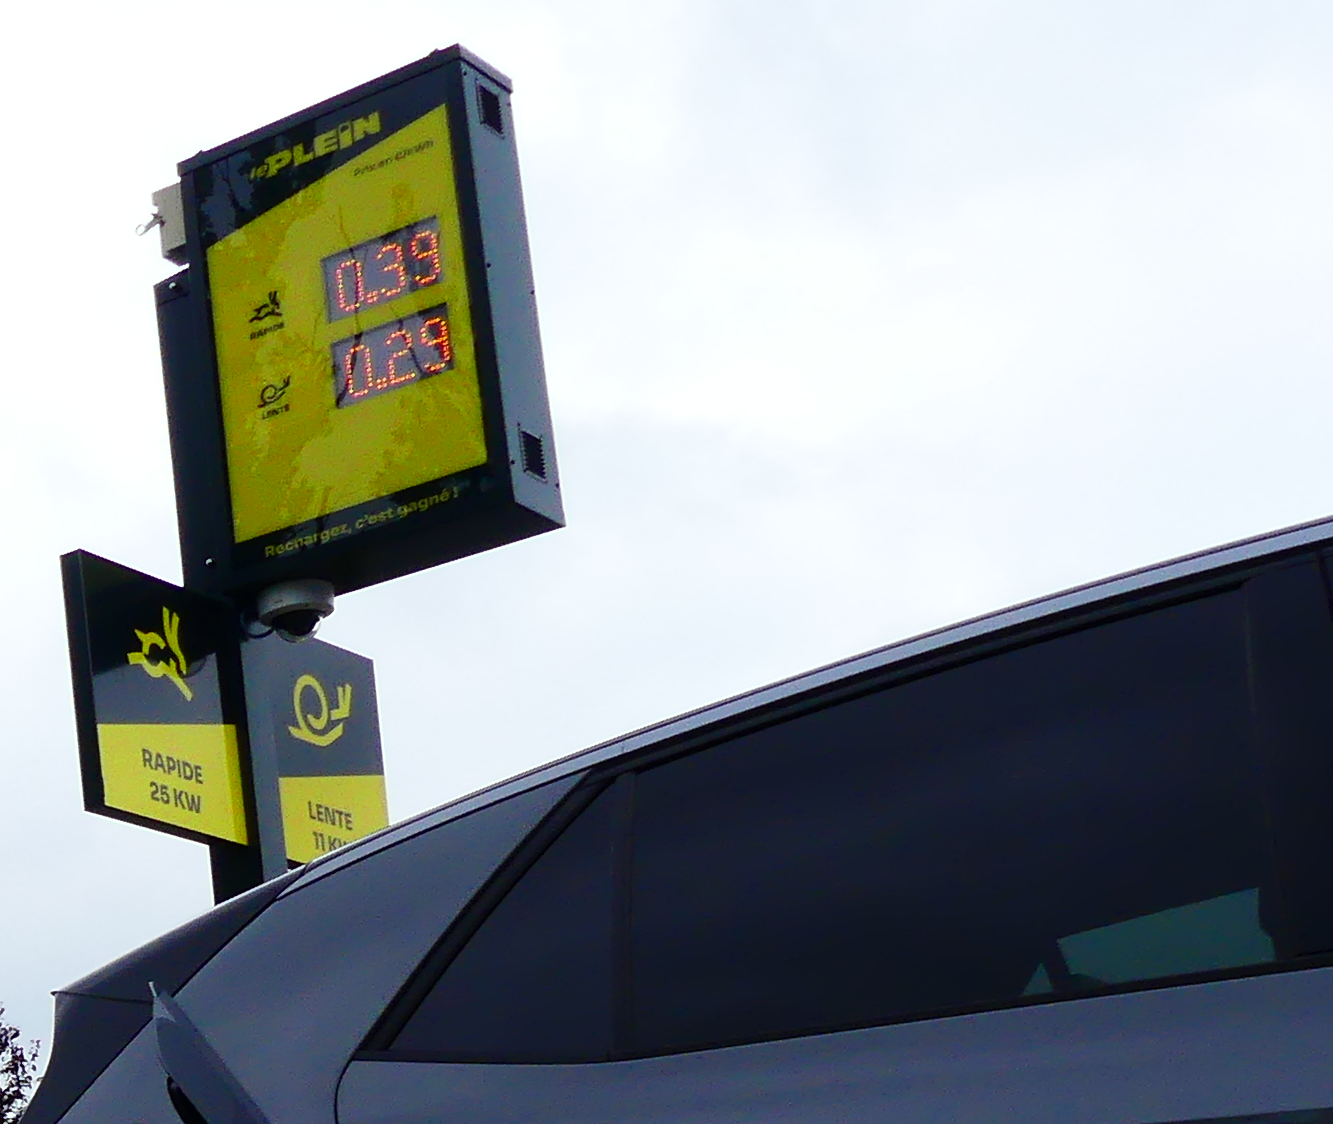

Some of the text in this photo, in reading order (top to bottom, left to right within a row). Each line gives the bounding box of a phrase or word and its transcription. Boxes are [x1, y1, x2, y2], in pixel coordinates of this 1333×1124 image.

[335, 230, 441, 313] 0.39
[344, 315, 451, 398] 0.29
[141, 747, 204, 785] RAPIDE
[150, 781, 171, 805] 25
[307, 800, 353, 831] LENTE
[313, 831, 326, 852] 11
